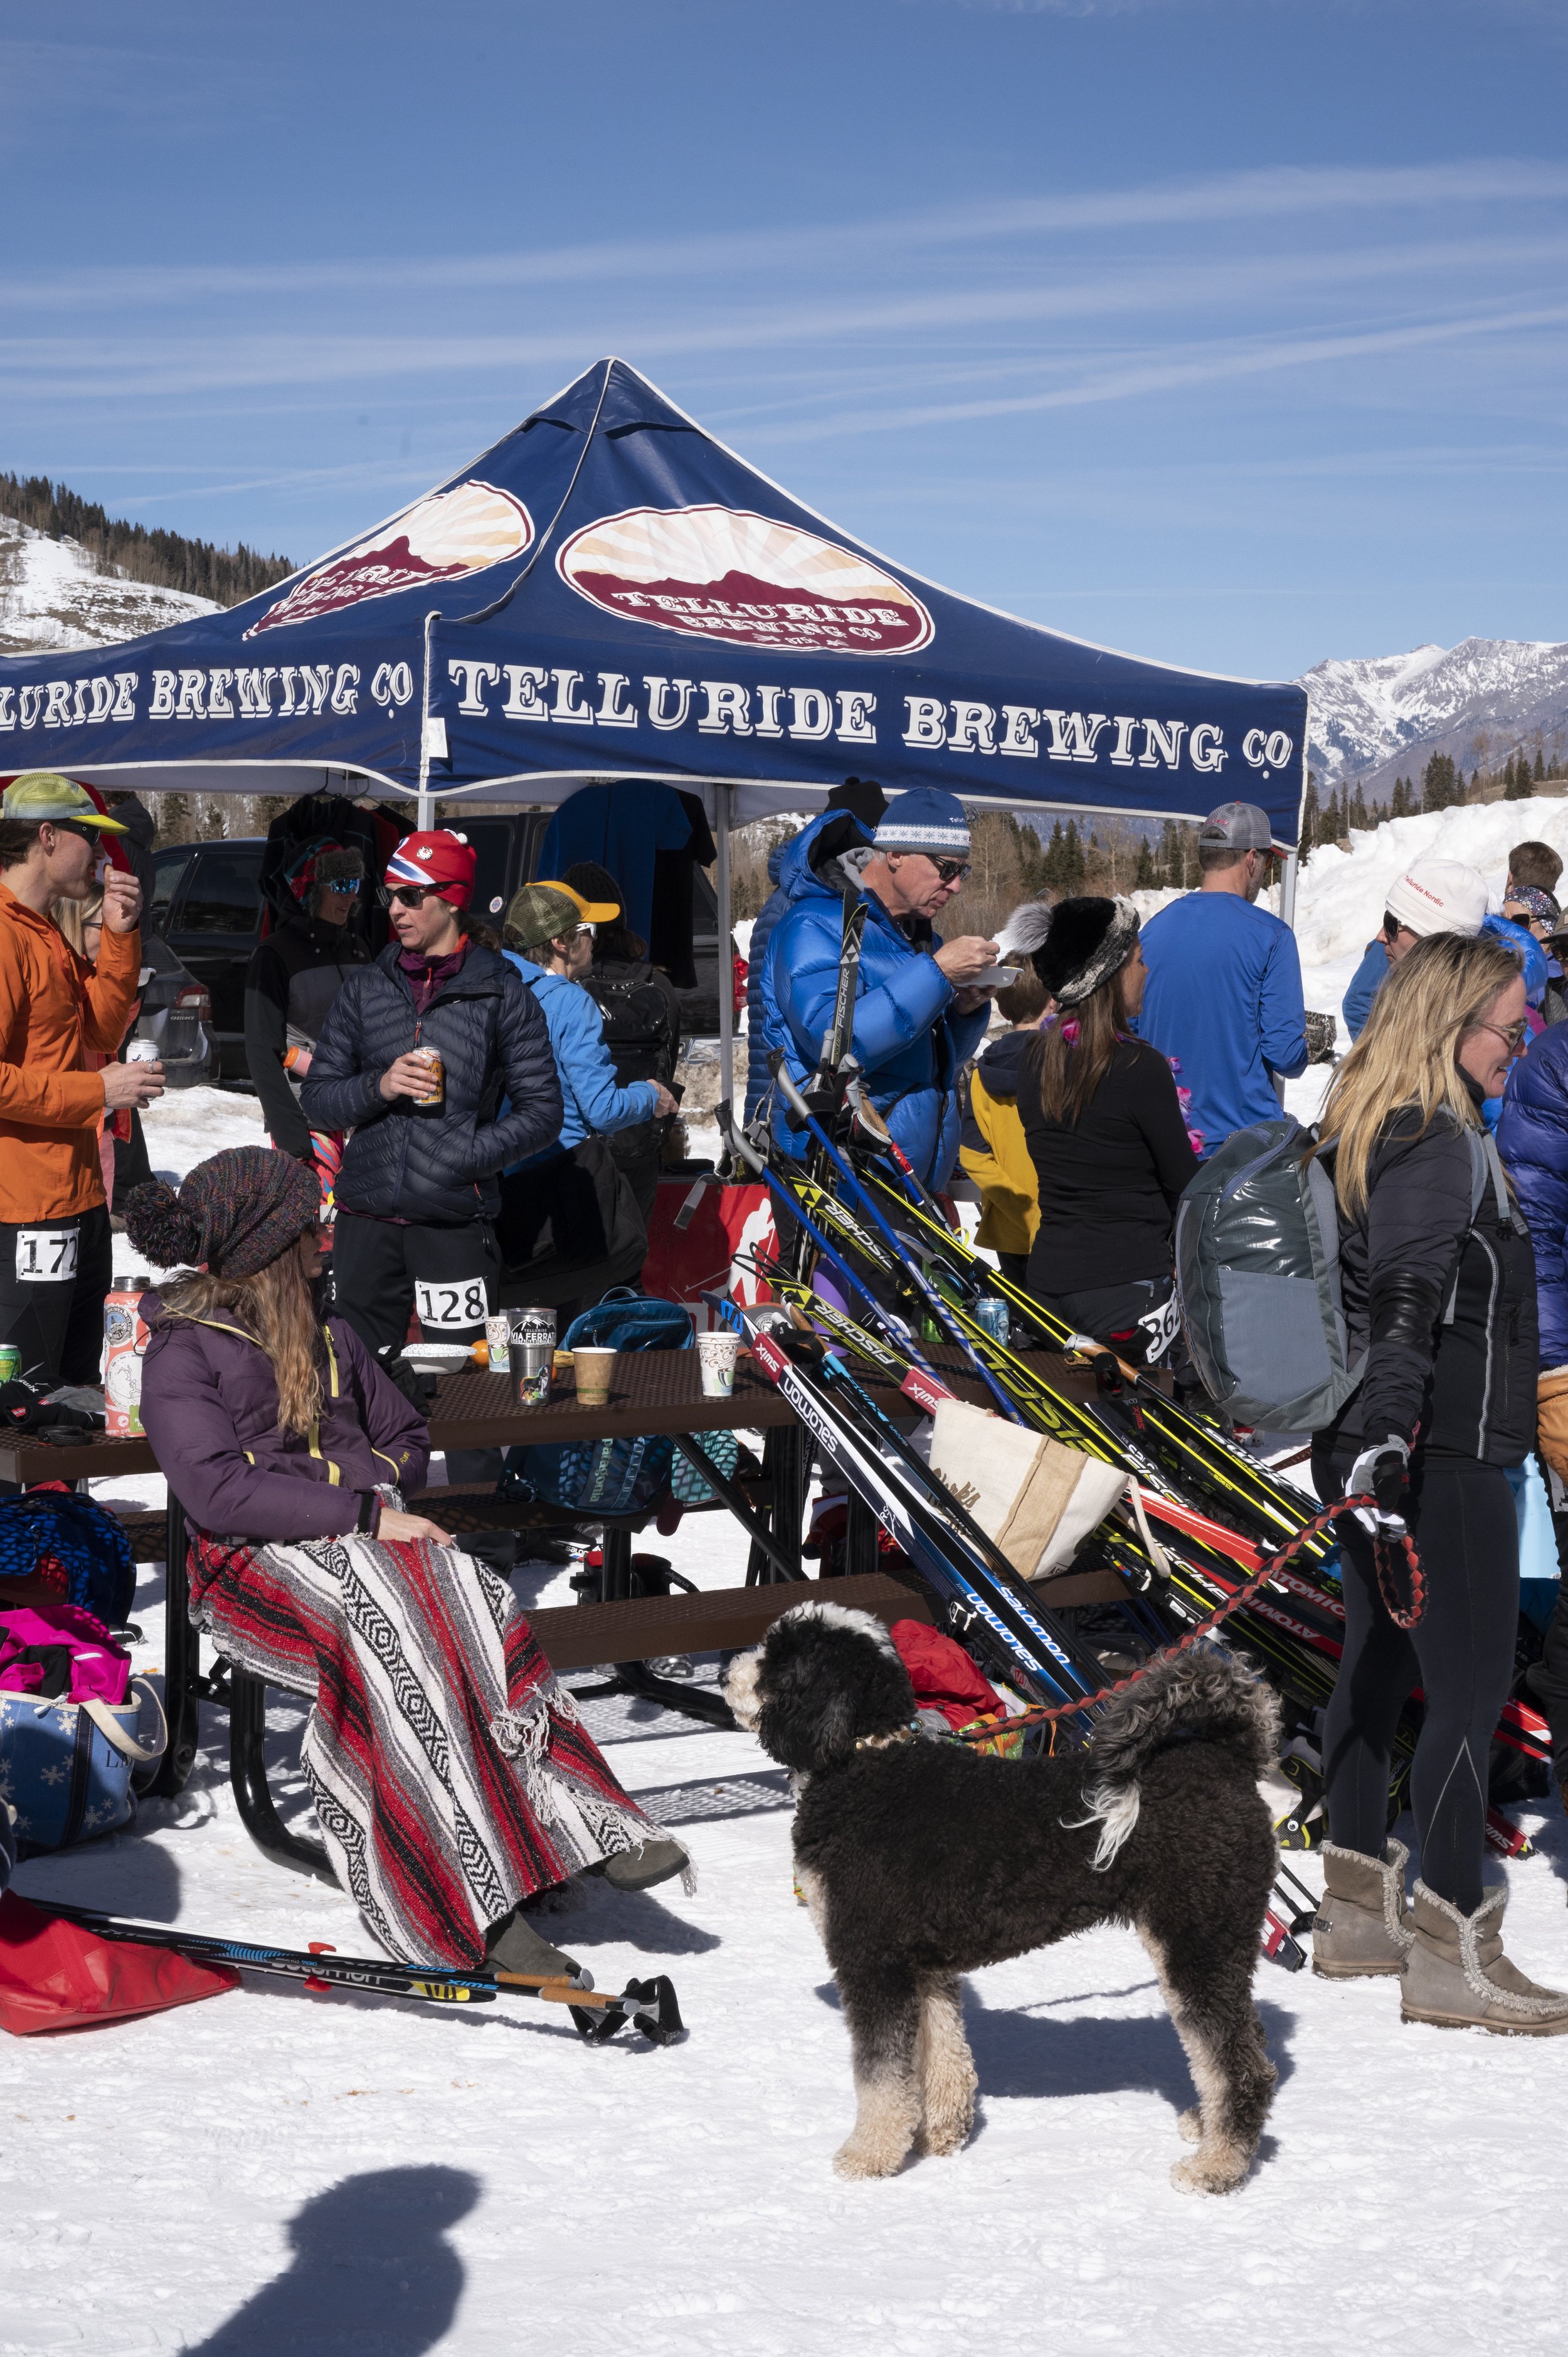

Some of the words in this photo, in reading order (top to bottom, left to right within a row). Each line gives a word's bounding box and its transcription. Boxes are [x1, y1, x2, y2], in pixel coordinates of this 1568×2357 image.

[611, 592, 909, 626] TELLURIDE
[674, 614, 847, 638] BREWING
[148, 662, 360, 720] BREWING
[448, 659, 877, 744] TELLURIDE
[902, 696, 1228, 772] BREWING
[837, 967, 850, 1028] FISCHER
[23, 1236, 77, 1274] 172
[421, 1285, 485, 1322] 128
[815, 1304, 896, 1365] FISCHER
[590, 1439, 613, 1502] patagonia
[1120, 1454, 1190, 1509] FISC
[1405, 1503, 1424, 1520] Telluride
[1424, 1518, 1444, 1535] Nordic
[1244, 1596, 1321, 1639] ATOMI
